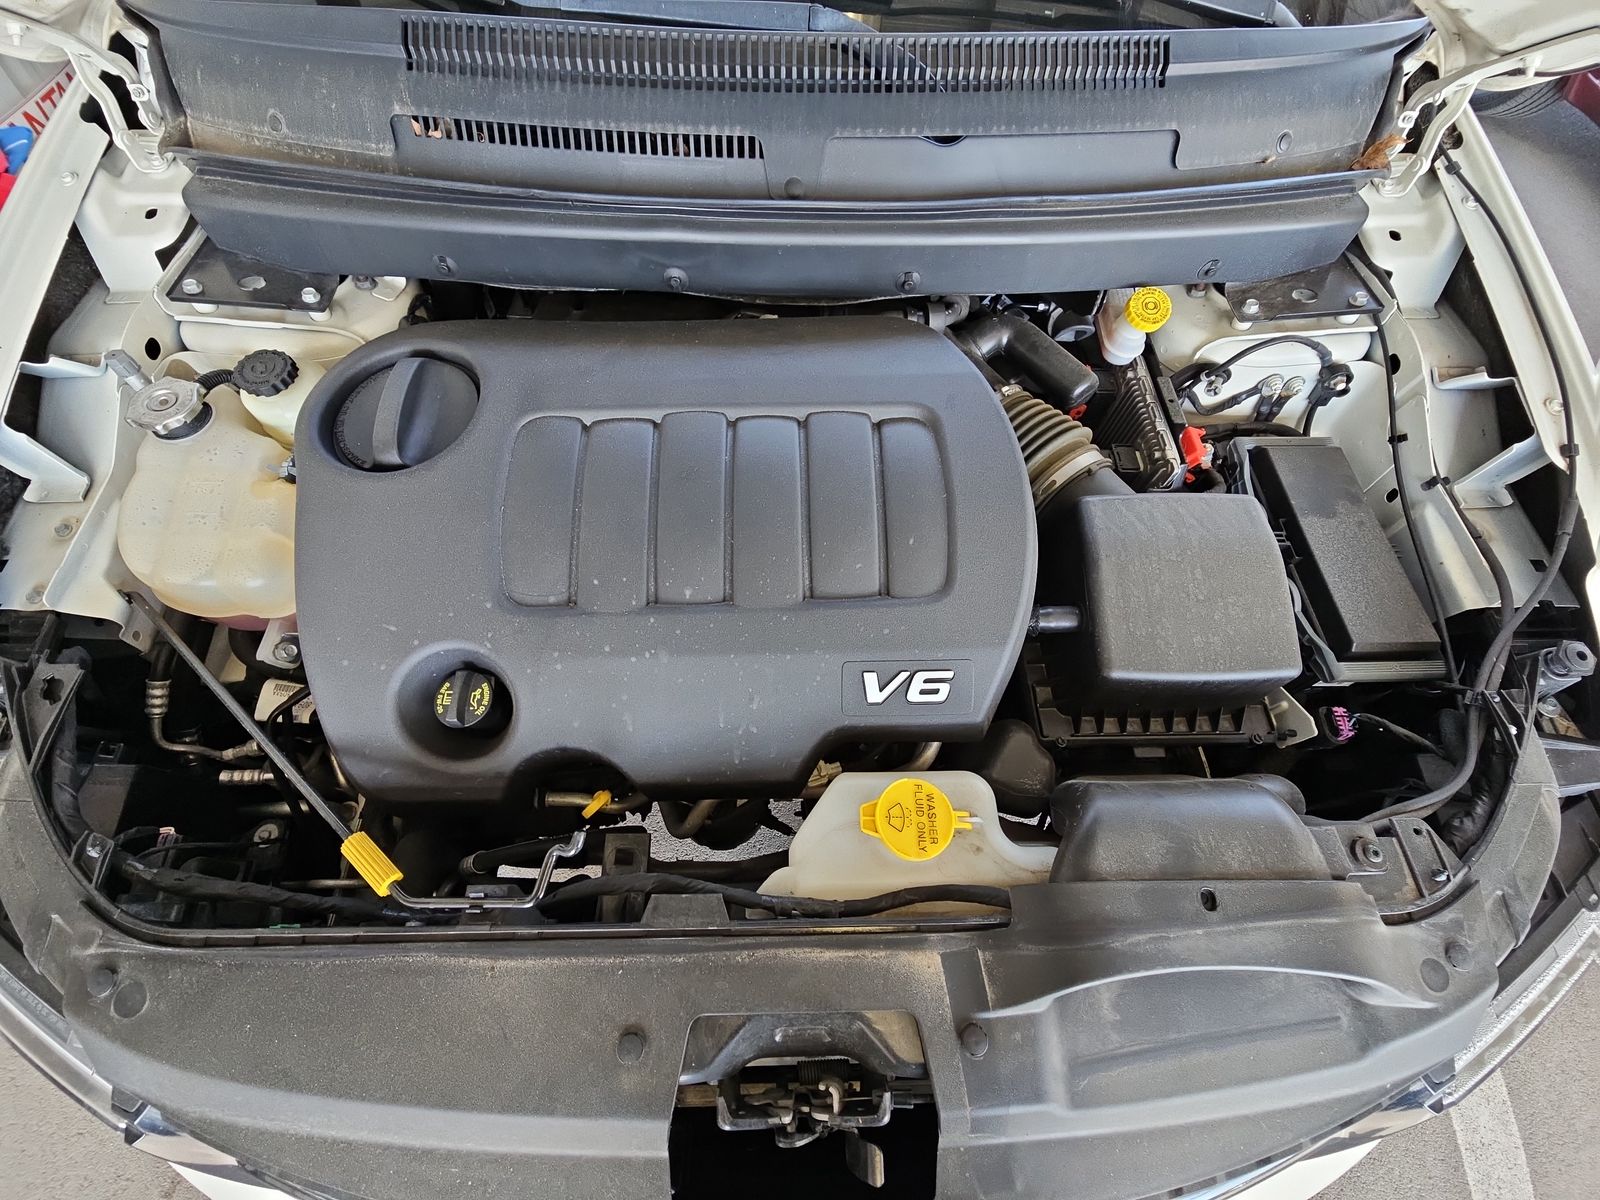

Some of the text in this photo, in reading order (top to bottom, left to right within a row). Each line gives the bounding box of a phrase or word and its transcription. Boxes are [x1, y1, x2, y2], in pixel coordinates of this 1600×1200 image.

[474, 682, 490, 716] ENGINE OIL
[862, 670, 955, 705] V6
[914, 784, 928, 853] FLUID ONLY
[926, 793, 939, 845] WASHER
